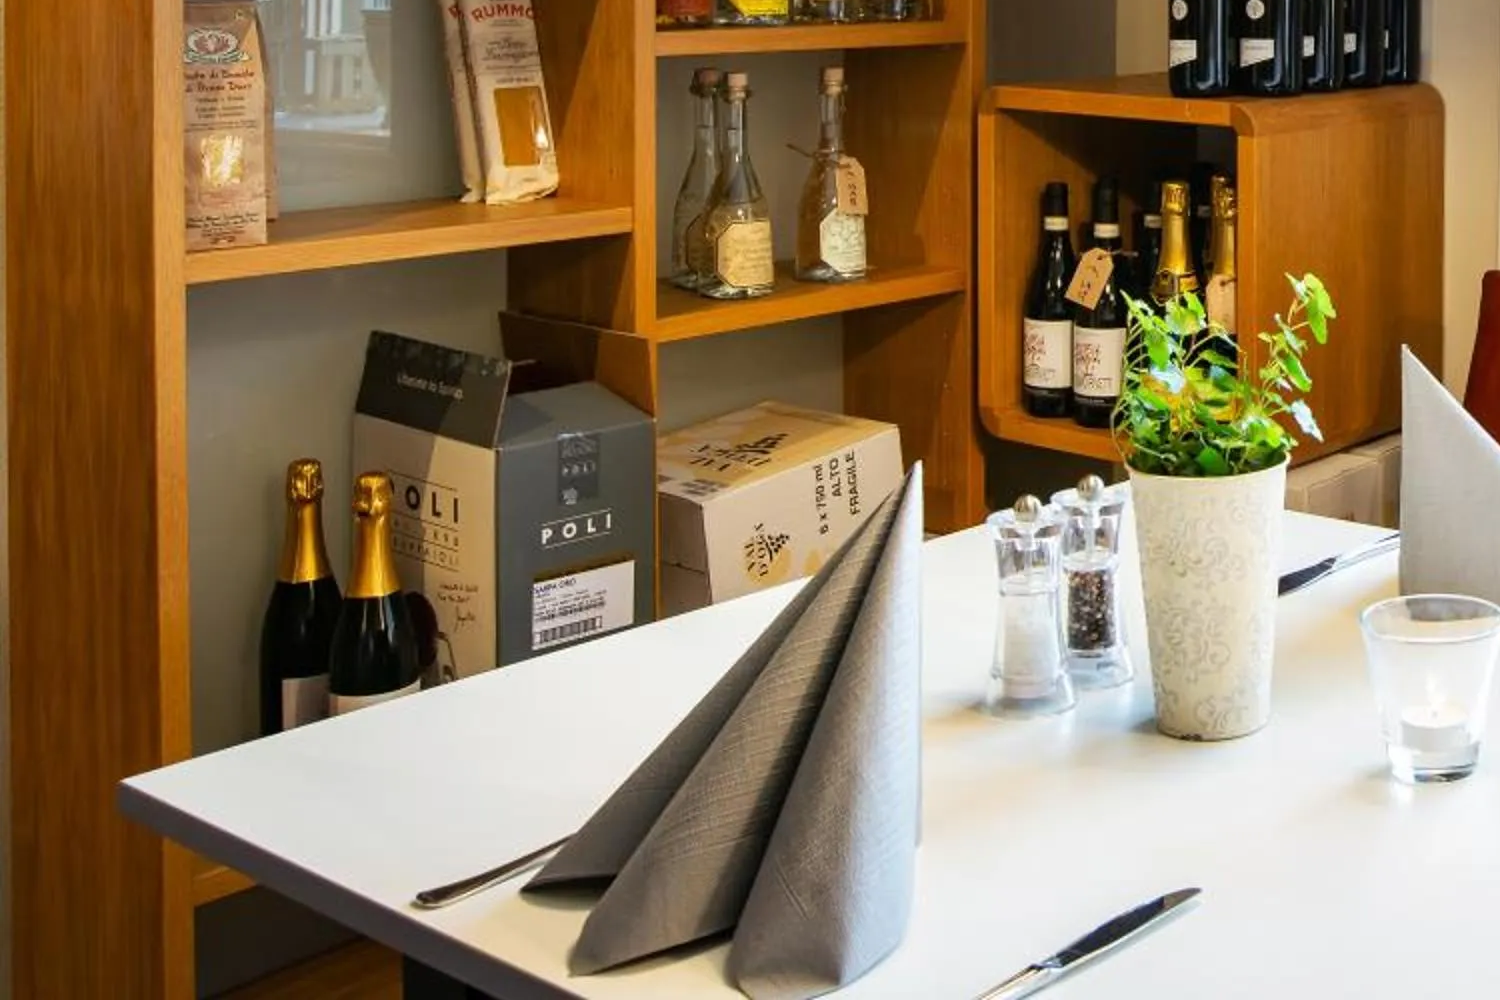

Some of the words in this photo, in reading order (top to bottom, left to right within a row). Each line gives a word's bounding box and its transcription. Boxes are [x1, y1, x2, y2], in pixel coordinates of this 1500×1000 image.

[829, 457, 842, 497] ALTO
[845, 449, 861, 516] FRAGILE
[389, 476, 459, 524] OLI
[541, 512, 612, 545] POLI
